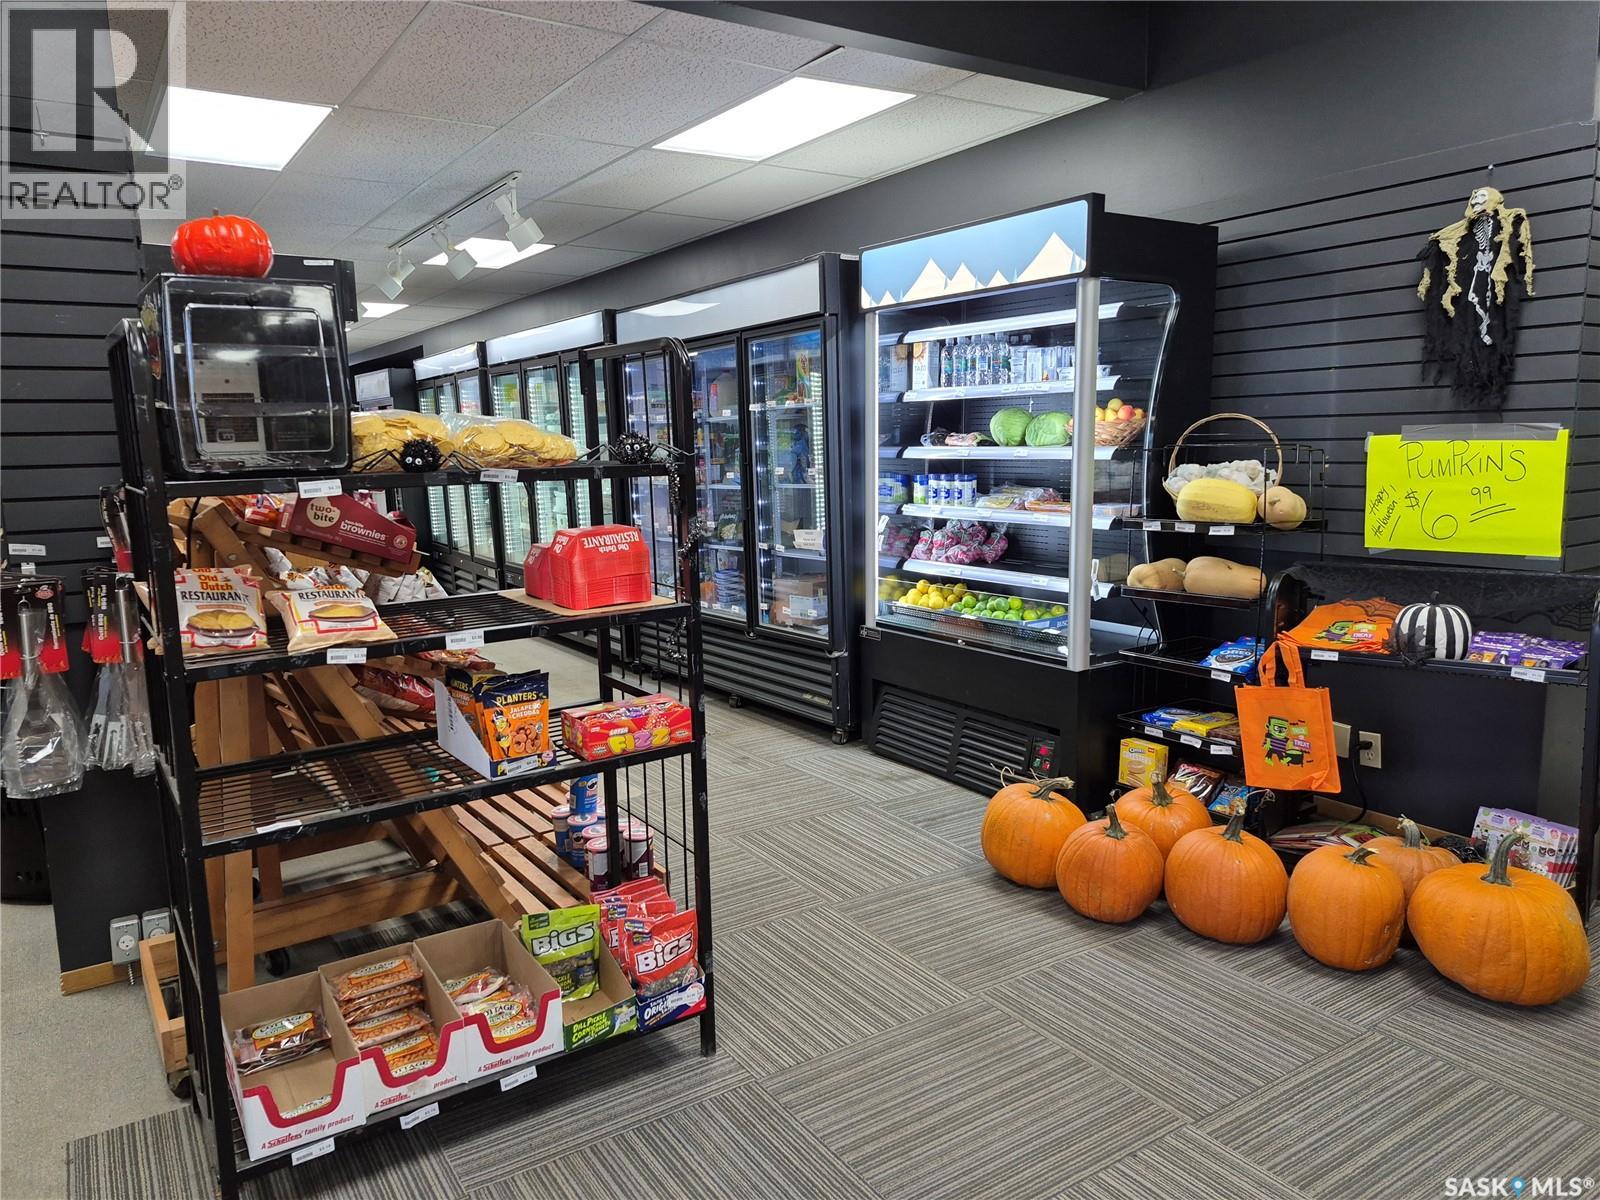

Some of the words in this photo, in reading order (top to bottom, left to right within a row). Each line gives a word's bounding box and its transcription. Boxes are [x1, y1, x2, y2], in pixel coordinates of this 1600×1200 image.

[313, 512, 335, 523] bite
[340, 521, 386, 541] brownies
[580, 531, 640, 548] RESTAURANTE
[496, 691, 538, 705] PLANTERS
[607, 727, 671, 755] FIZZ
[532, 1043, 555, 1056] product
[433, 1076, 457, 1089] product
[304, 1123, 326, 1136] family
[327, 1114, 354, 1128] product
